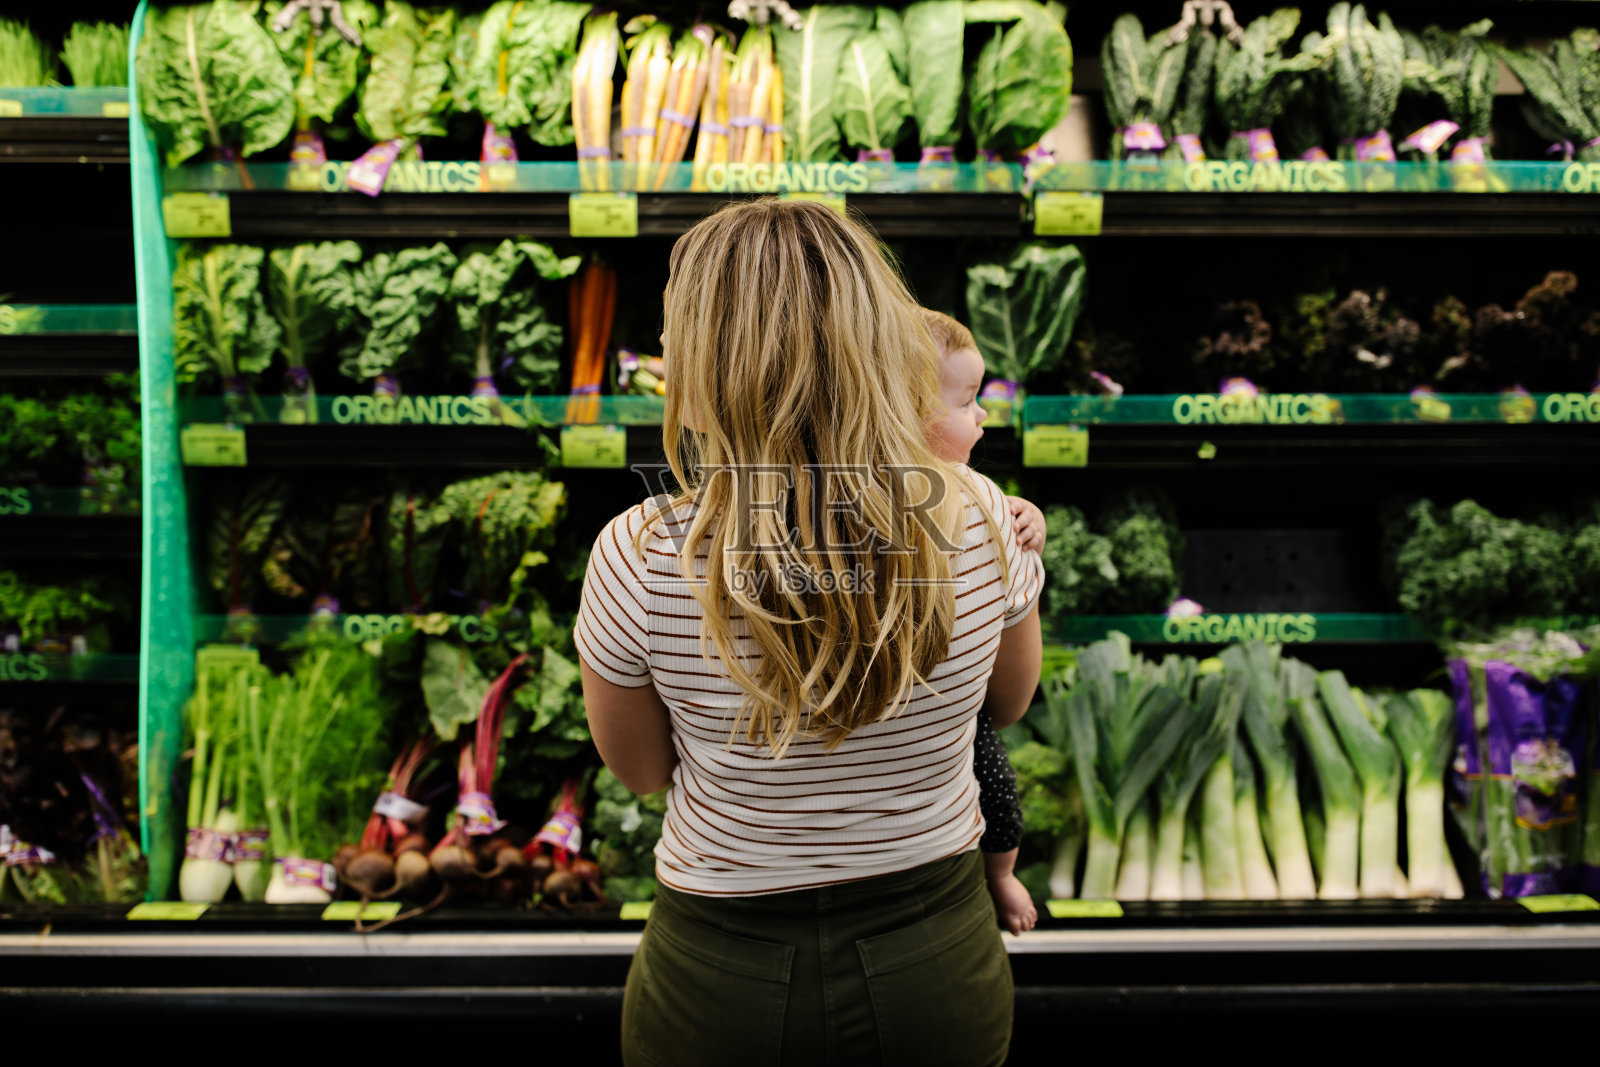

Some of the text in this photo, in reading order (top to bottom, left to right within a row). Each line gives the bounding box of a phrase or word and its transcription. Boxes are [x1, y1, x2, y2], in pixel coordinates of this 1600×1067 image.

[321, 162, 481, 192] OANICS
[706, 163, 869, 192] ORGANICS
[1184, 161, 1345, 192] ORGANICS
[331, 395, 491, 424] ORGANICS
[1172, 394, 1331, 424] ORGANICS
[1163, 614, 1316, 643] ORGANICS
